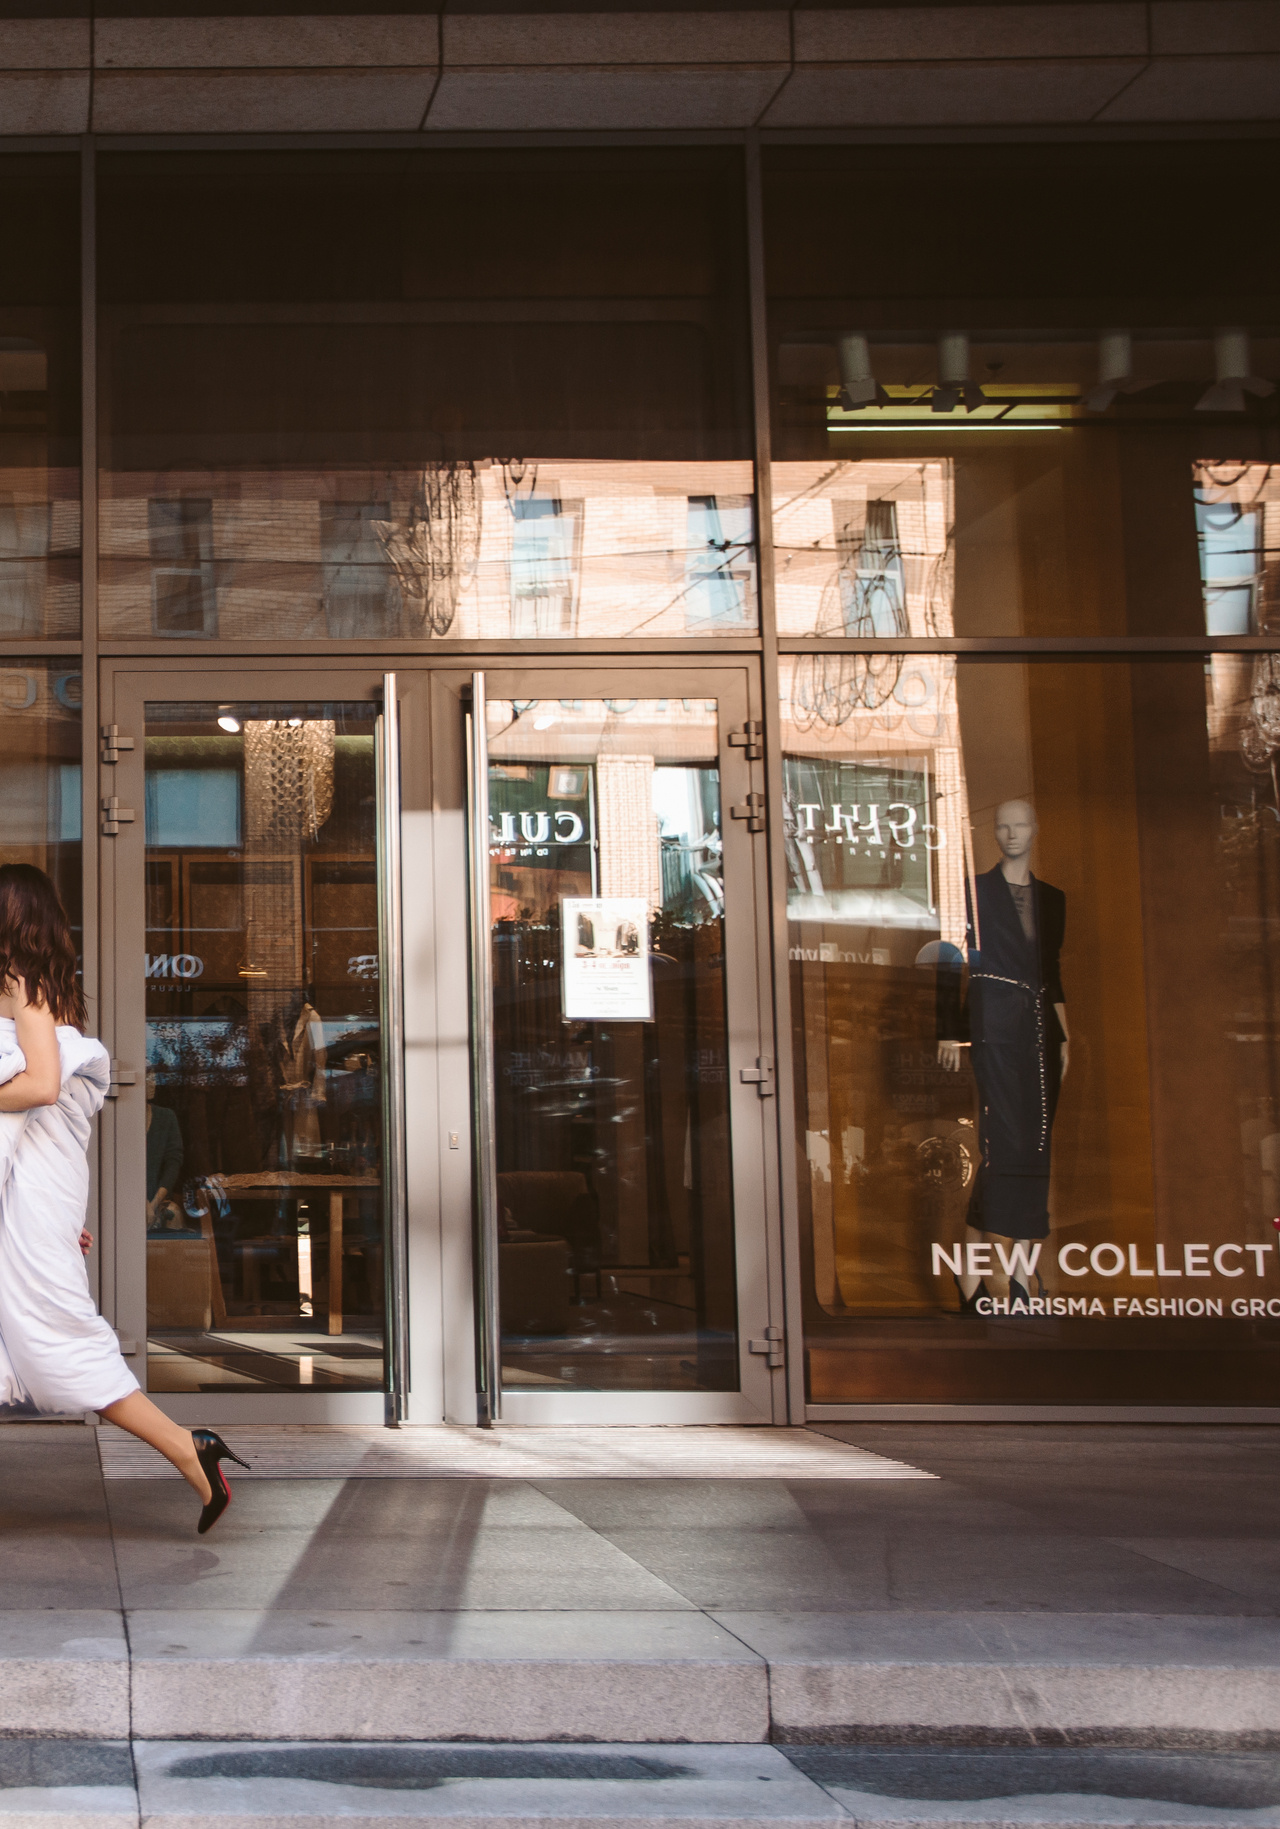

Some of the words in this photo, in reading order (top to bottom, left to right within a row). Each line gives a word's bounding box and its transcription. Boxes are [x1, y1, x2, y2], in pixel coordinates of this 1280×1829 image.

[931, 1243, 1042, 1277] NEW
[1058, 1242, 1280, 1278] COLLECT
[975, 1296, 1106, 1316] CHARISMA
[1113, 1297, 1223, 1317] FASHION
